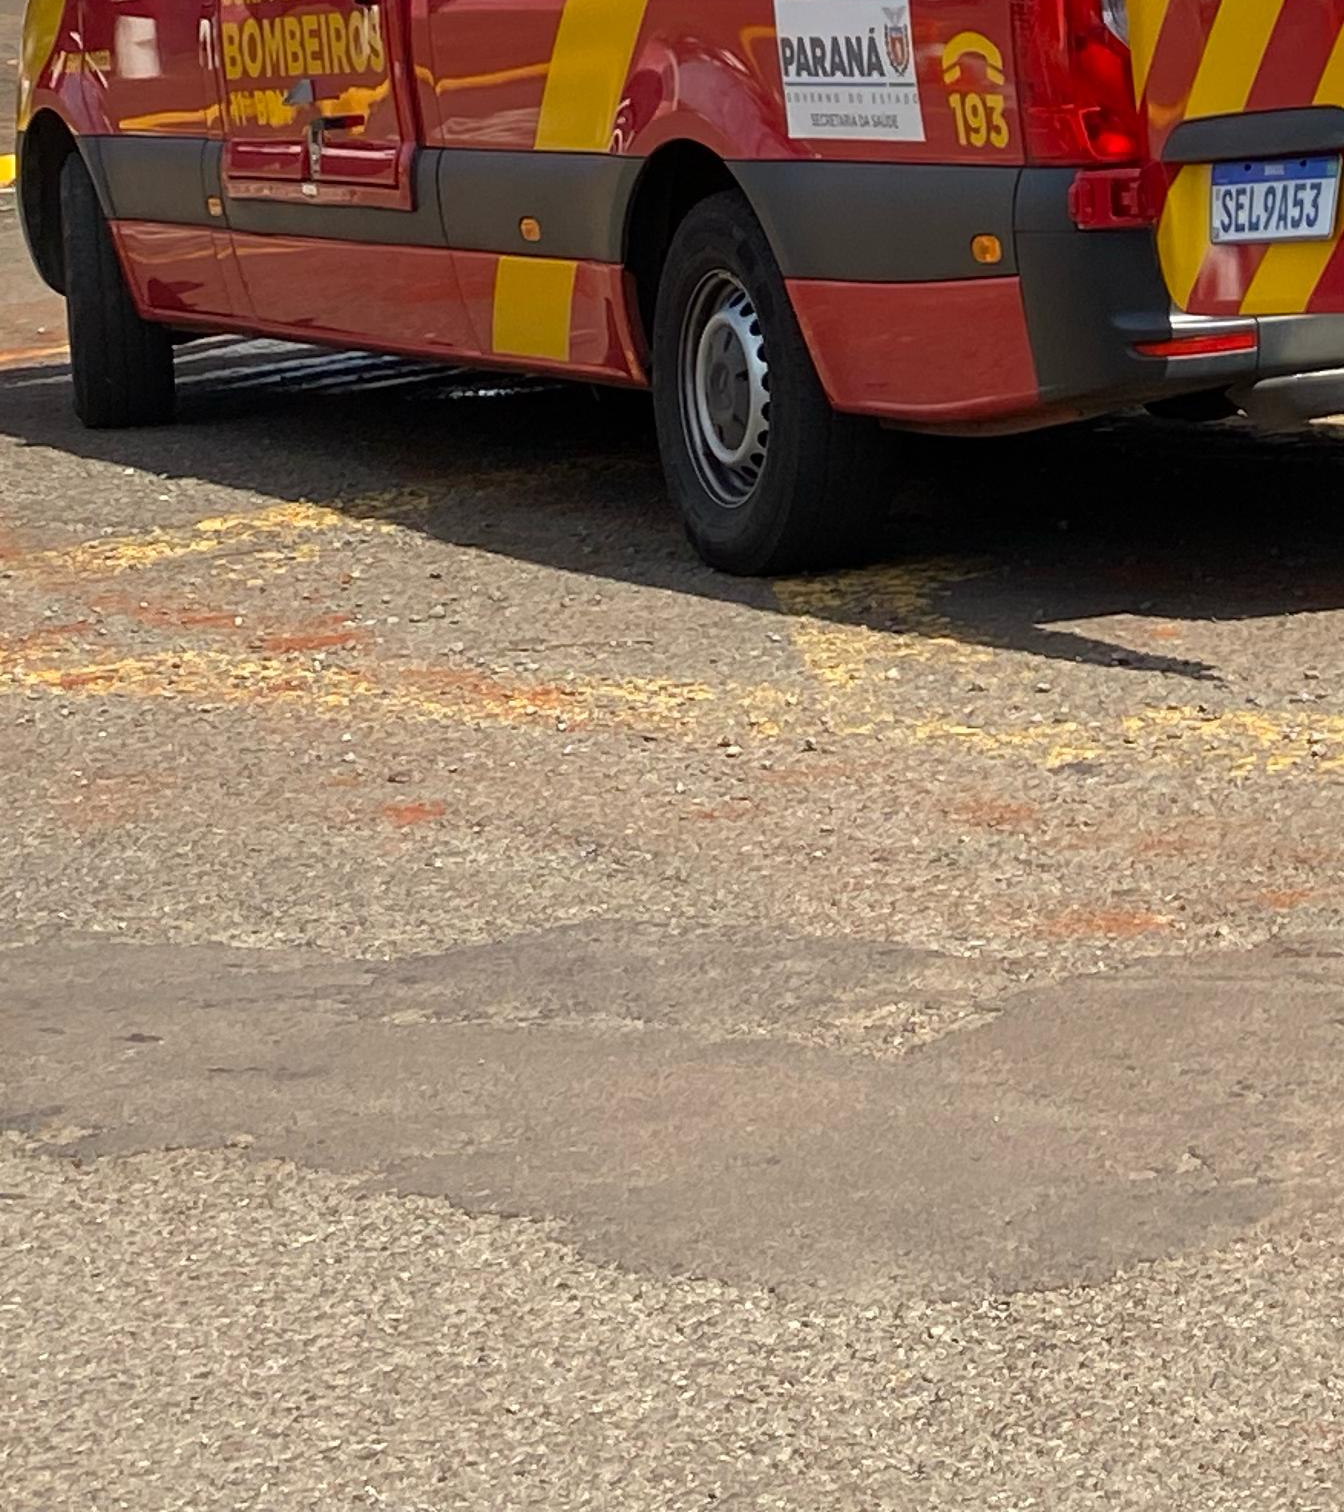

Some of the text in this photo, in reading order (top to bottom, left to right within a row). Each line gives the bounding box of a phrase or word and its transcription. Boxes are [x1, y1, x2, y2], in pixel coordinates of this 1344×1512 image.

[222, 6, 385, 80] BOMBEIROS
[781, 28, 887, 78] PARANÁ
[949, 93, 1009, 148] 193
[1220, 182, 1322, 233] SEL9A53
